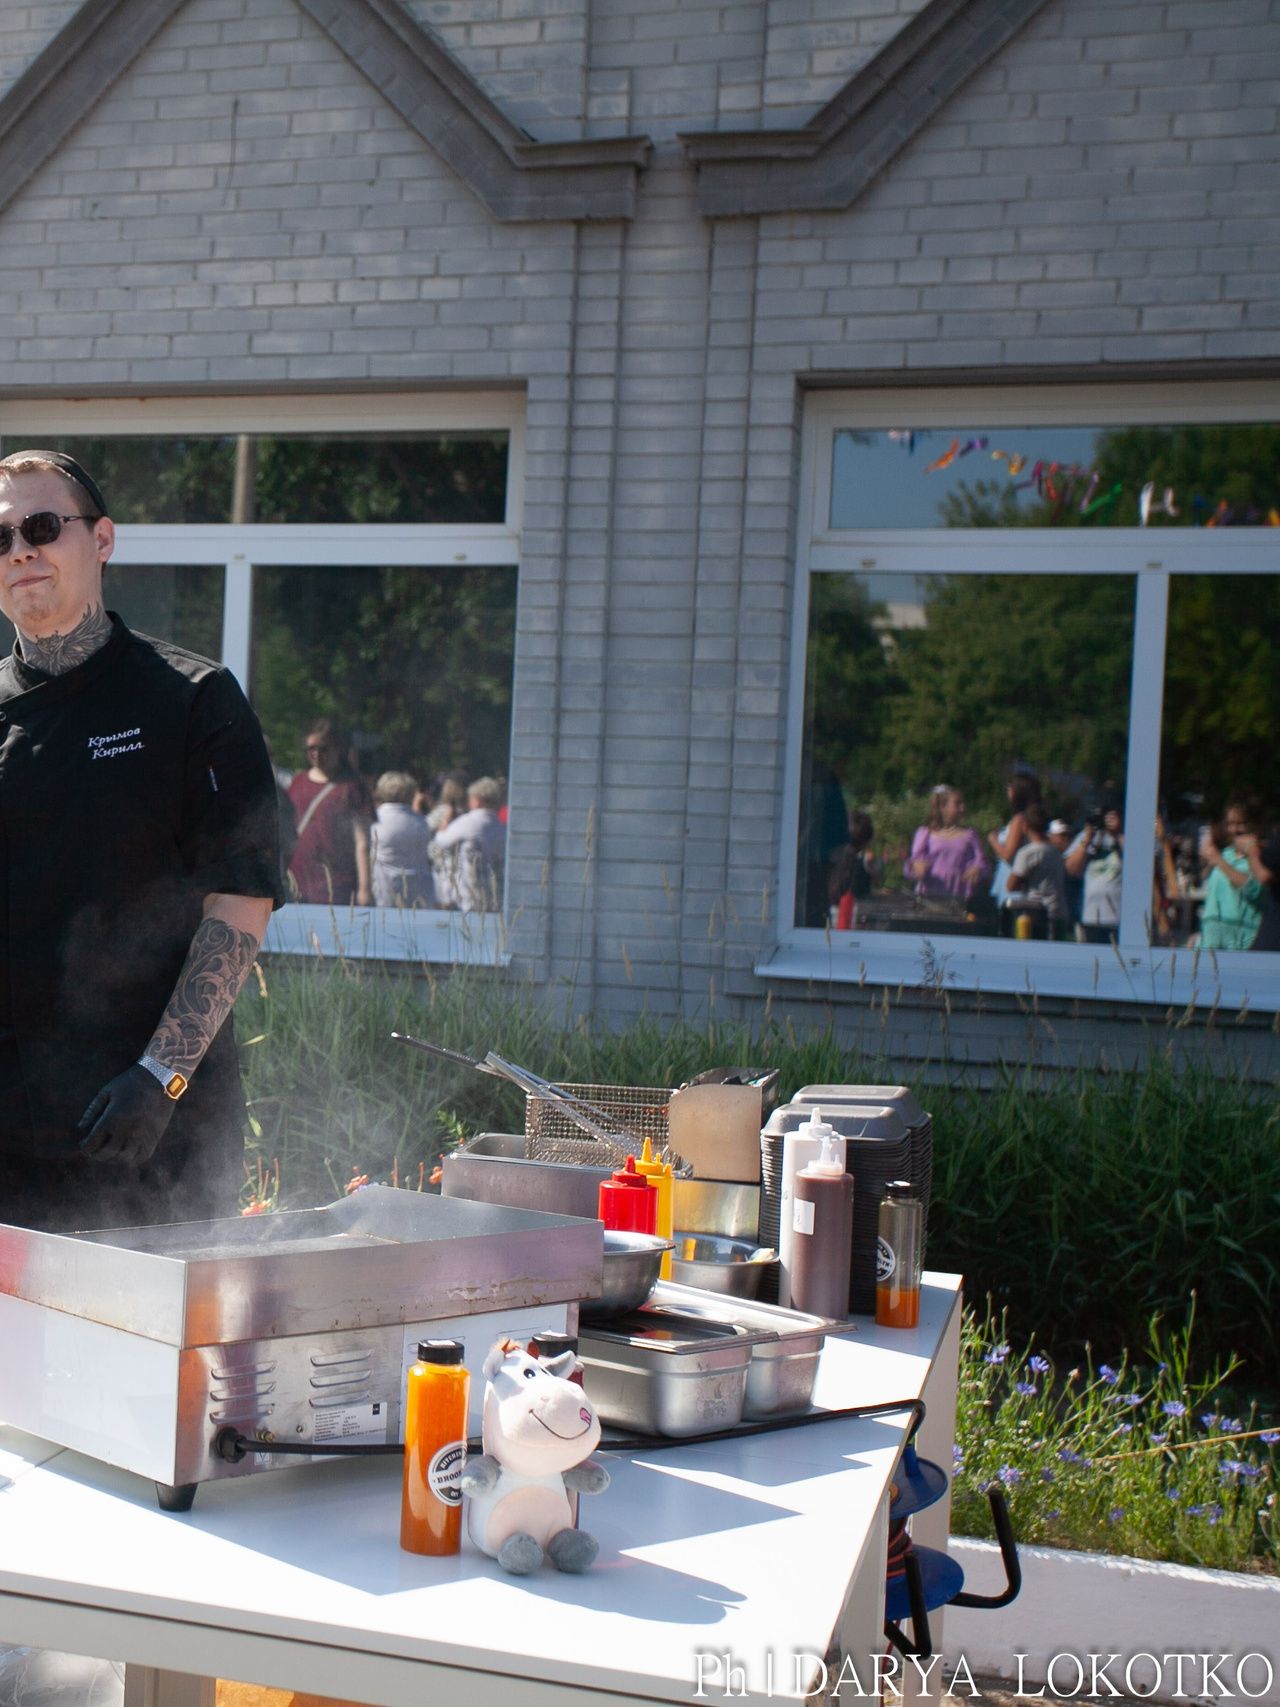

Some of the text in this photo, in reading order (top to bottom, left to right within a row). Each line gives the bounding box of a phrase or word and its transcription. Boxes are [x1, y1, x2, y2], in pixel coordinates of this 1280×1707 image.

[87, 727, 141, 748] Крымов
[92, 741, 145, 760] Кирилл
[437, 1470, 462, 1484] BROO
